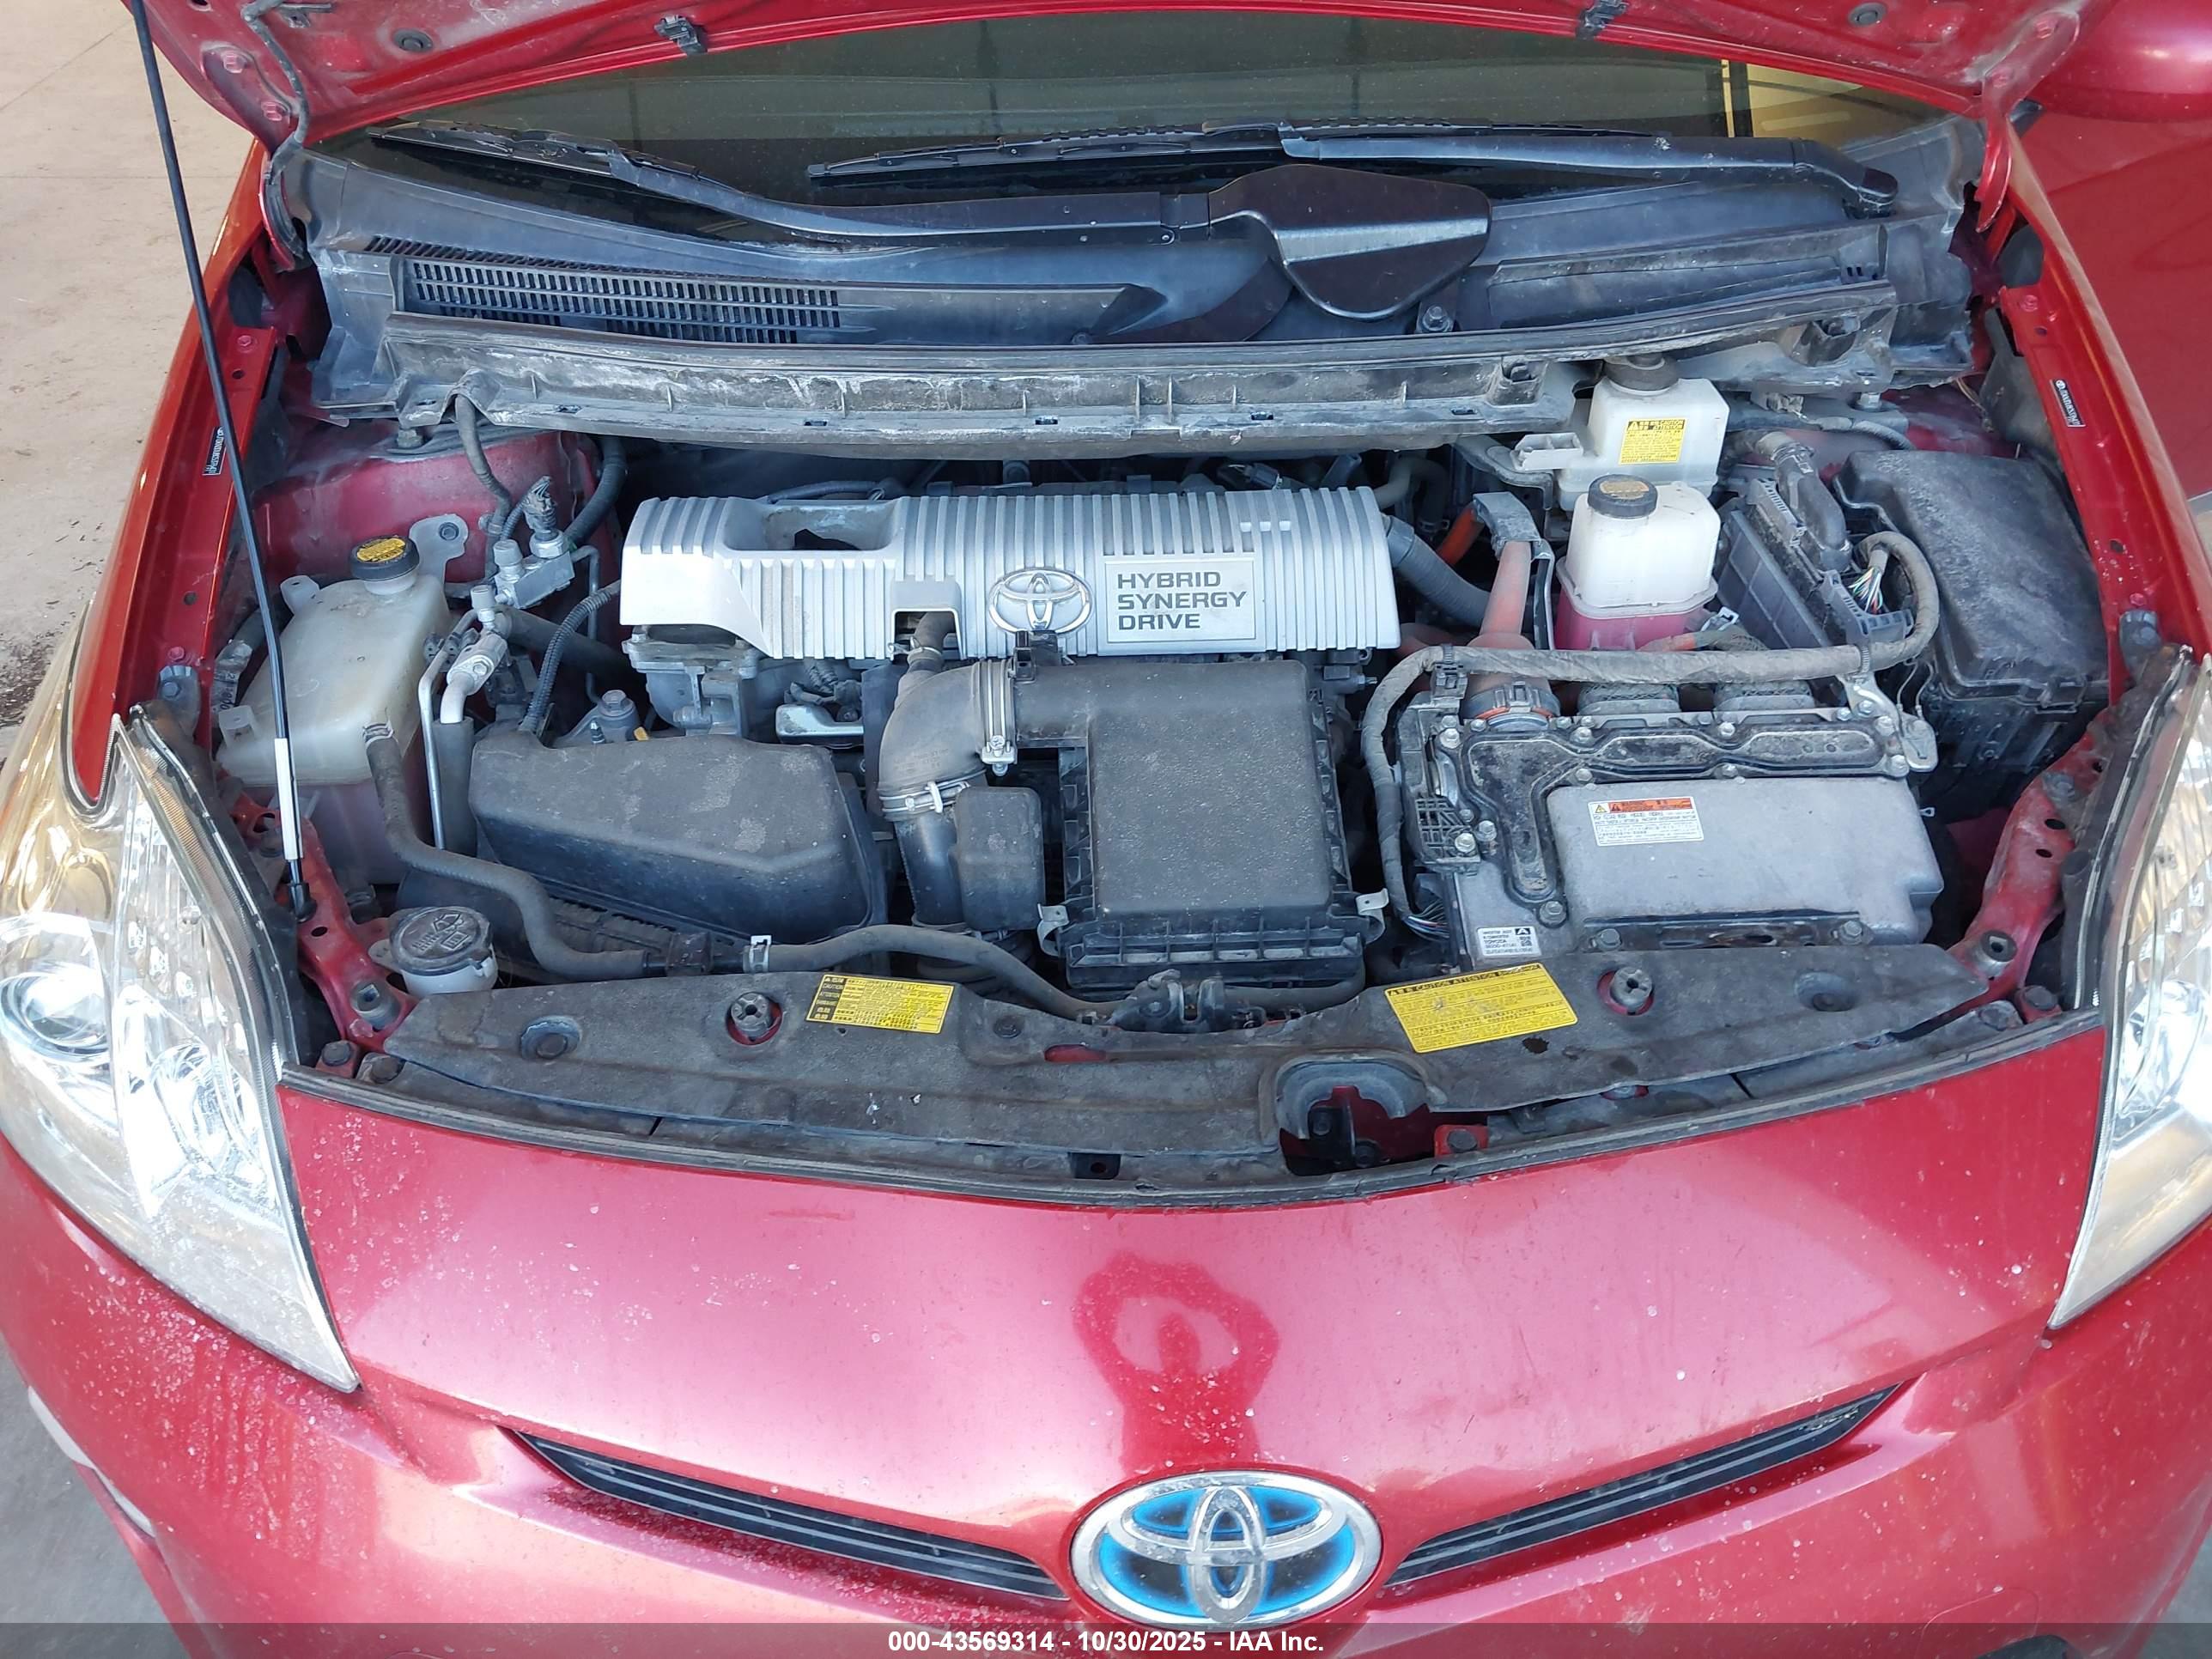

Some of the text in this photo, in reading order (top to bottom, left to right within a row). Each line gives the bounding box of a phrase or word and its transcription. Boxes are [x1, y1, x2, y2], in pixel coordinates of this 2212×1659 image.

[1117, 571, 1221, 589] HYBRID
[1118, 591, 1247, 610] SYNERGY
[1118, 613, 1200, 630] DRIVE
